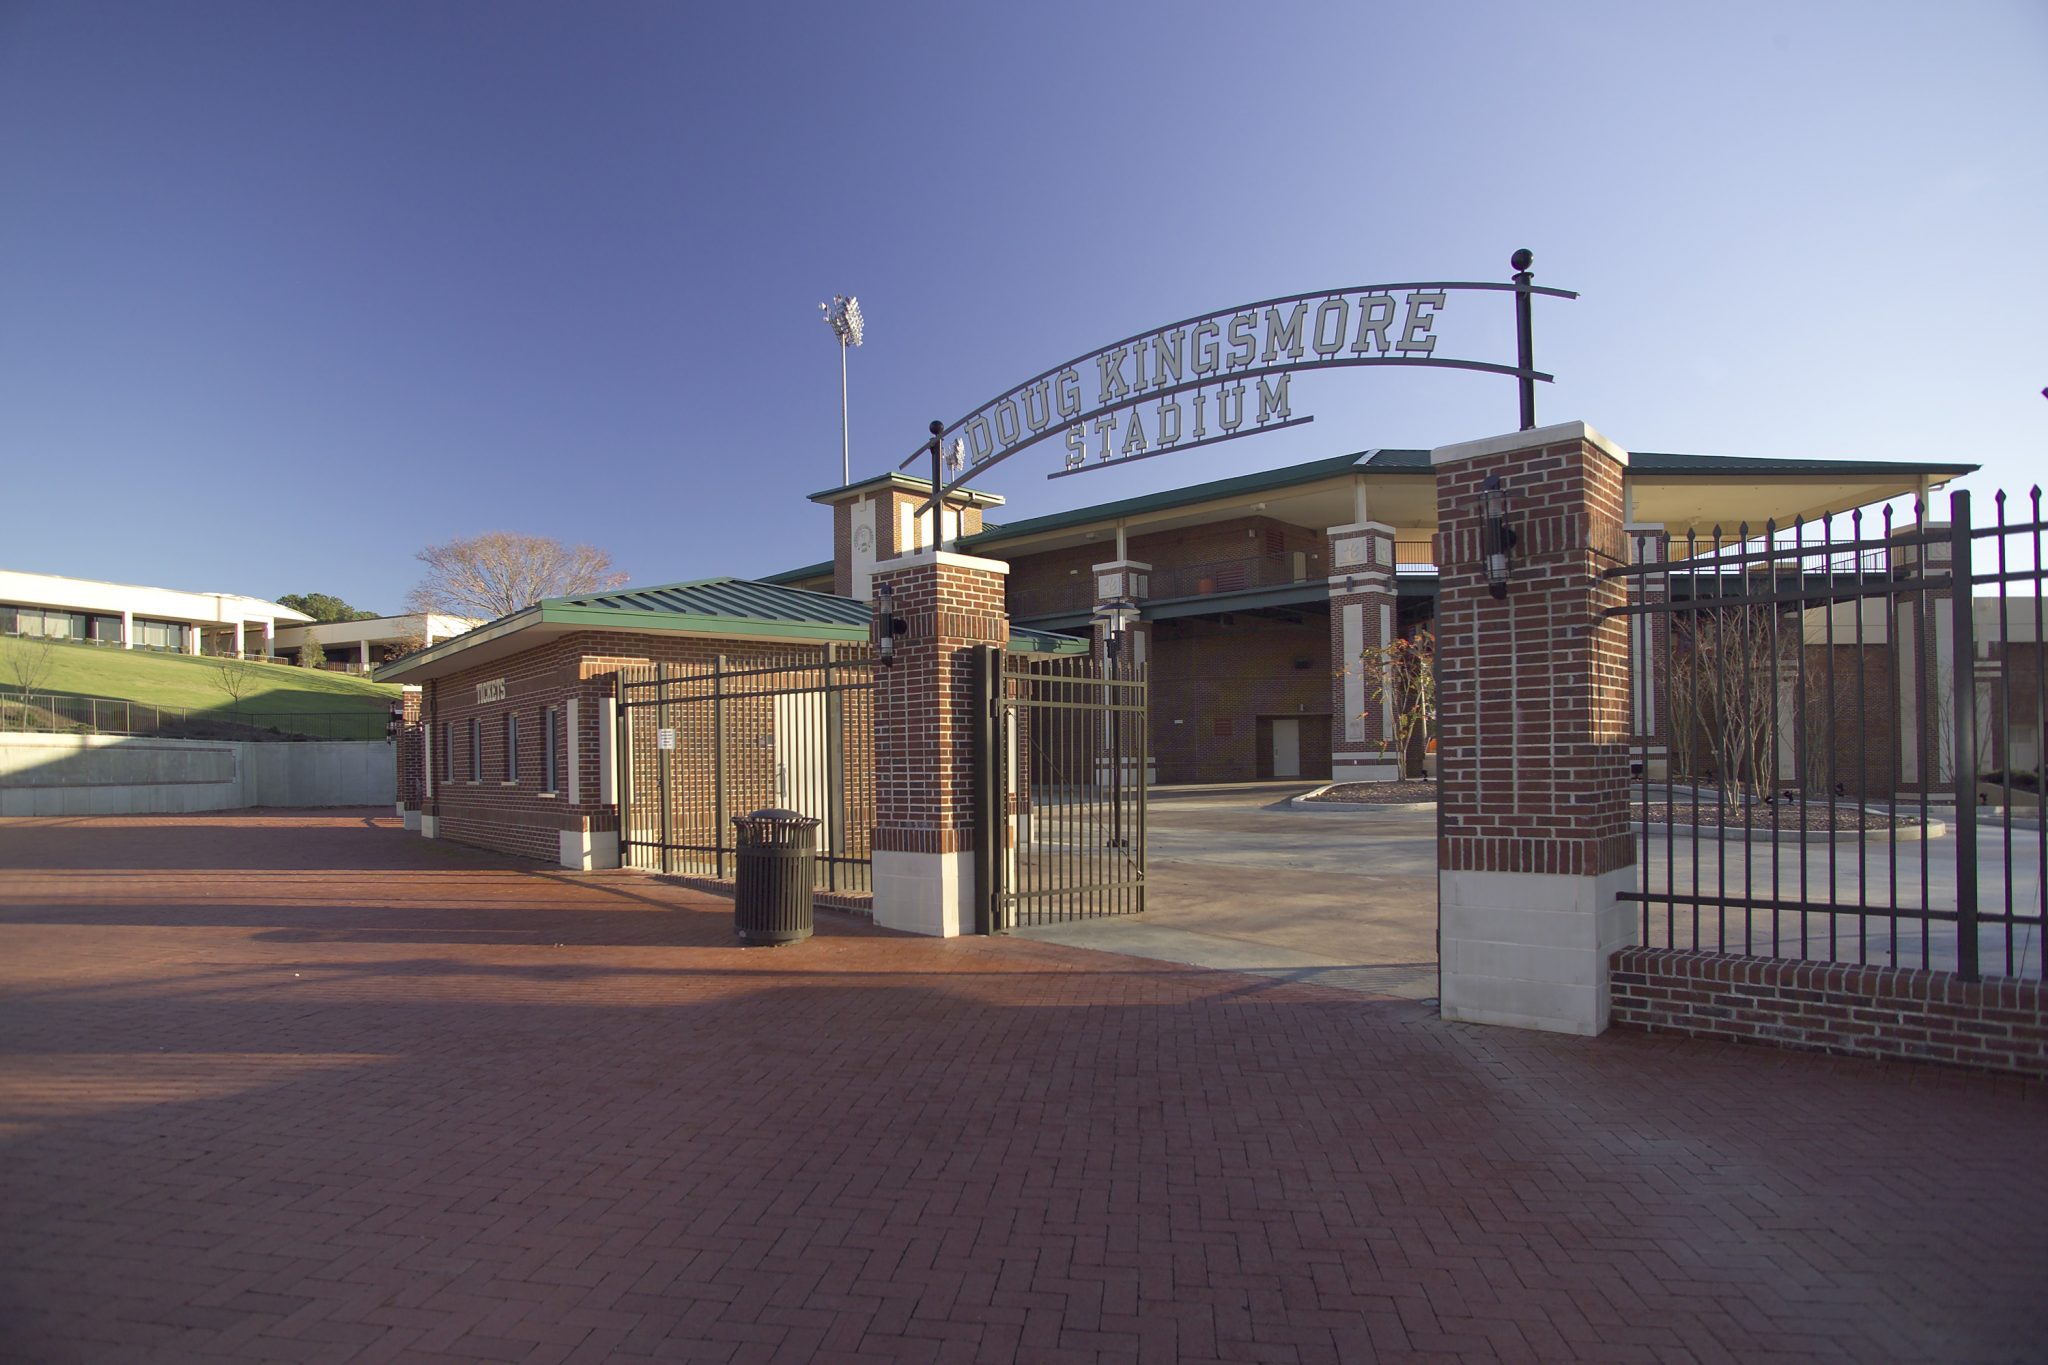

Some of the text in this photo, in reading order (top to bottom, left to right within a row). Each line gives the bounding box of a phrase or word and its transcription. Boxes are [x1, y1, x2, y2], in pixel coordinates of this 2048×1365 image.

[964, 293, 1447, 465] DOUG KINGSMORE
[1064, 374, 1292, 467] STADIUM
[476, 677, 506, 705] TICKETS
